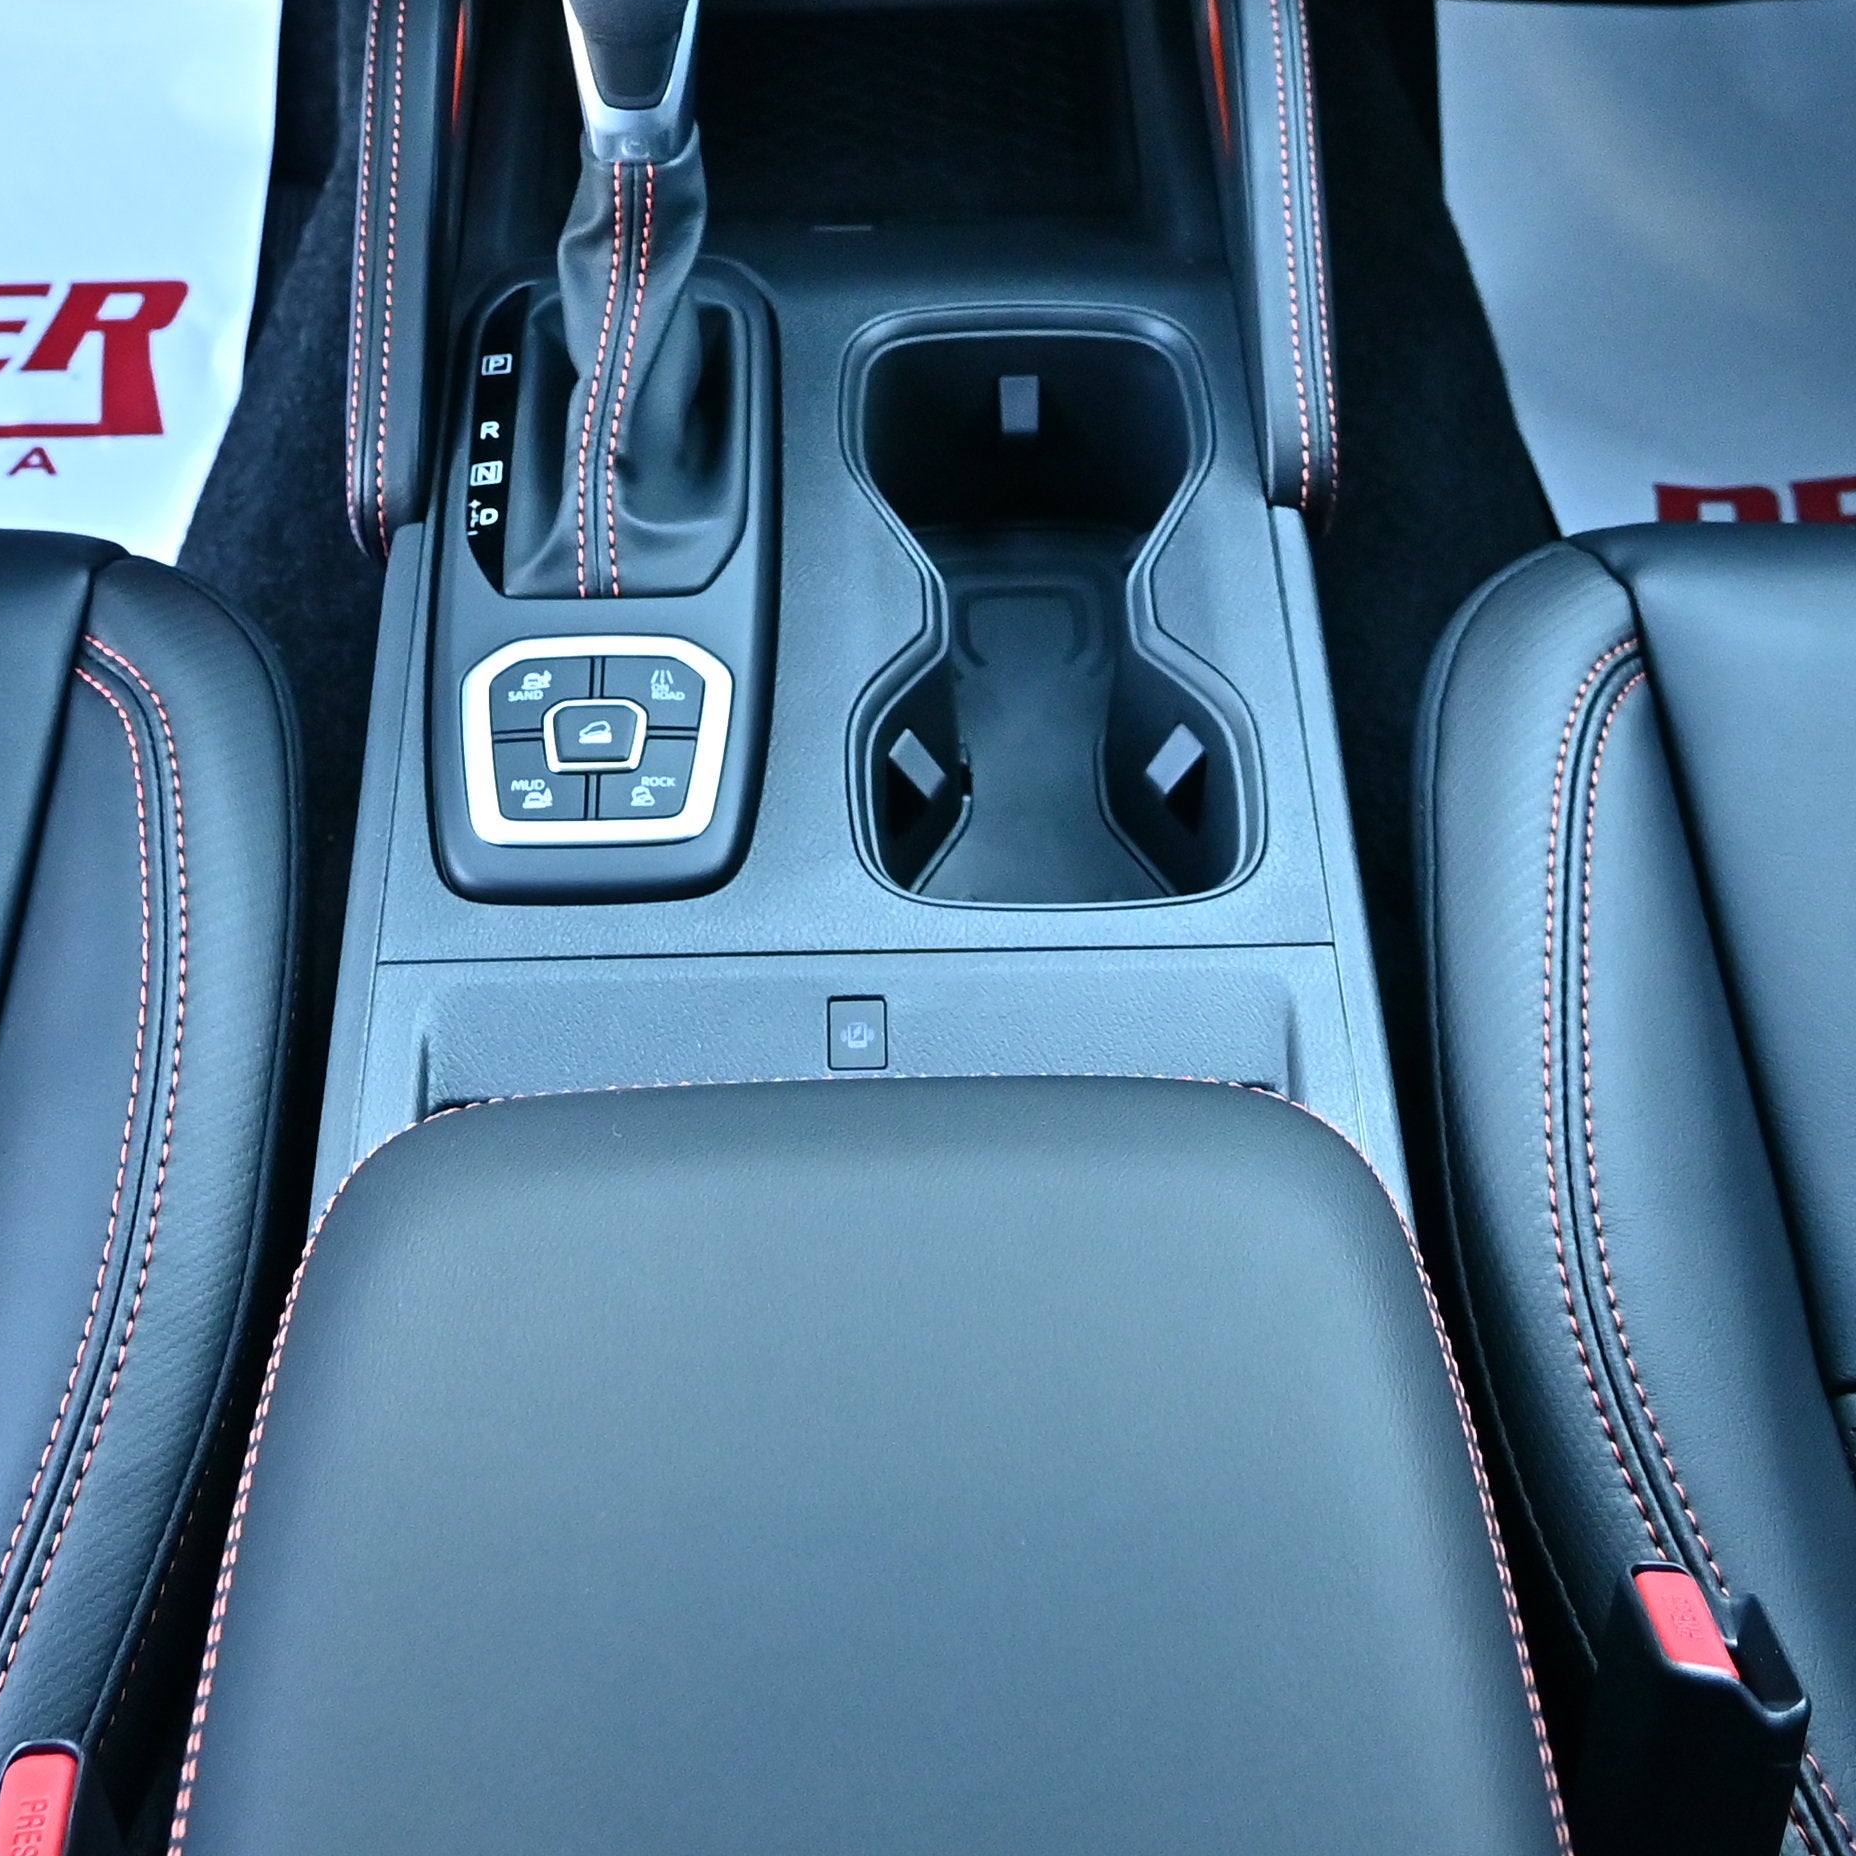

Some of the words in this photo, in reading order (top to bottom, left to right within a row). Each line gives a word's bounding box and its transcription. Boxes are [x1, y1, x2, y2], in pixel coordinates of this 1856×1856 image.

[480, 420, 500, 440] R
[477, 463, 496, 483] N
[479, 507, 499, 526] D
[508, 690, 544, 702] SAND
[651, 691, 685, 701] ROAD
[511, 779, 546, 792] MUD
[641, 776, 676, 787] ROCK
